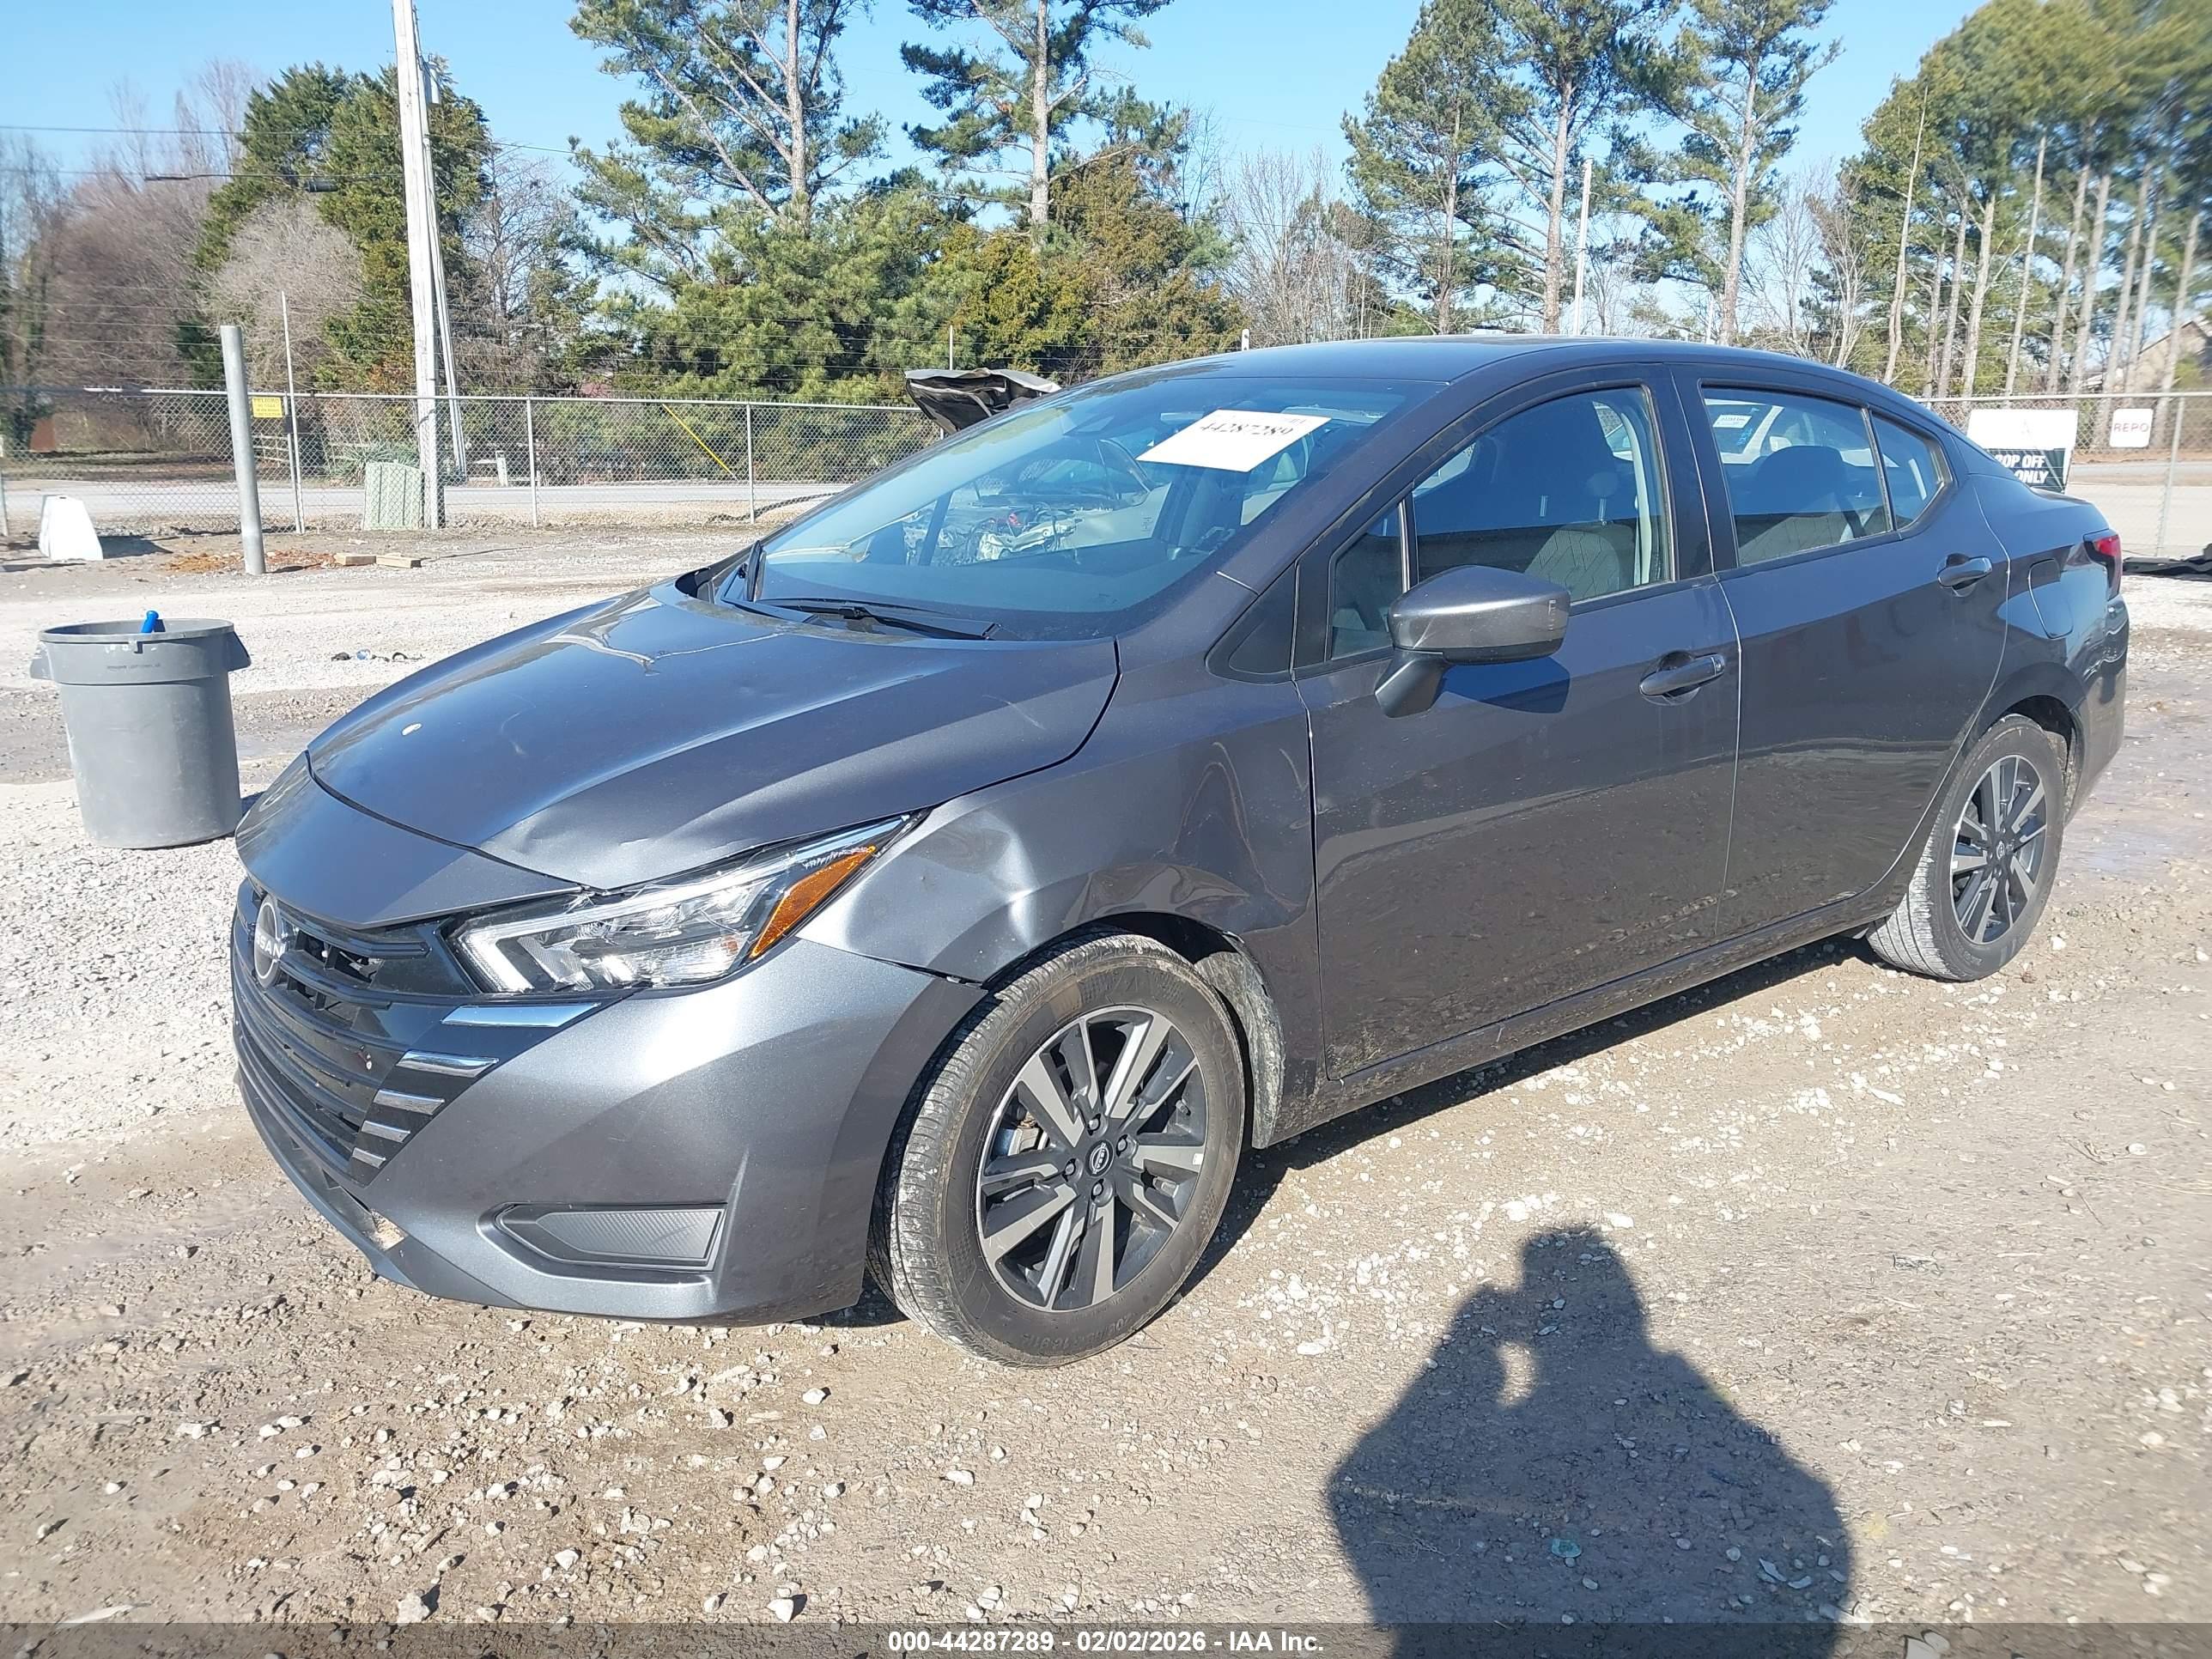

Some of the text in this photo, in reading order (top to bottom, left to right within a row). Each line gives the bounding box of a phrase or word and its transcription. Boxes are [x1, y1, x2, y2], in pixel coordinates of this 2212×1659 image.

[2114, 422, 2149, 432] REPO
[2022, 454, 2046, 468] OFF
[2014, 470, 2049, 483] ONLY
